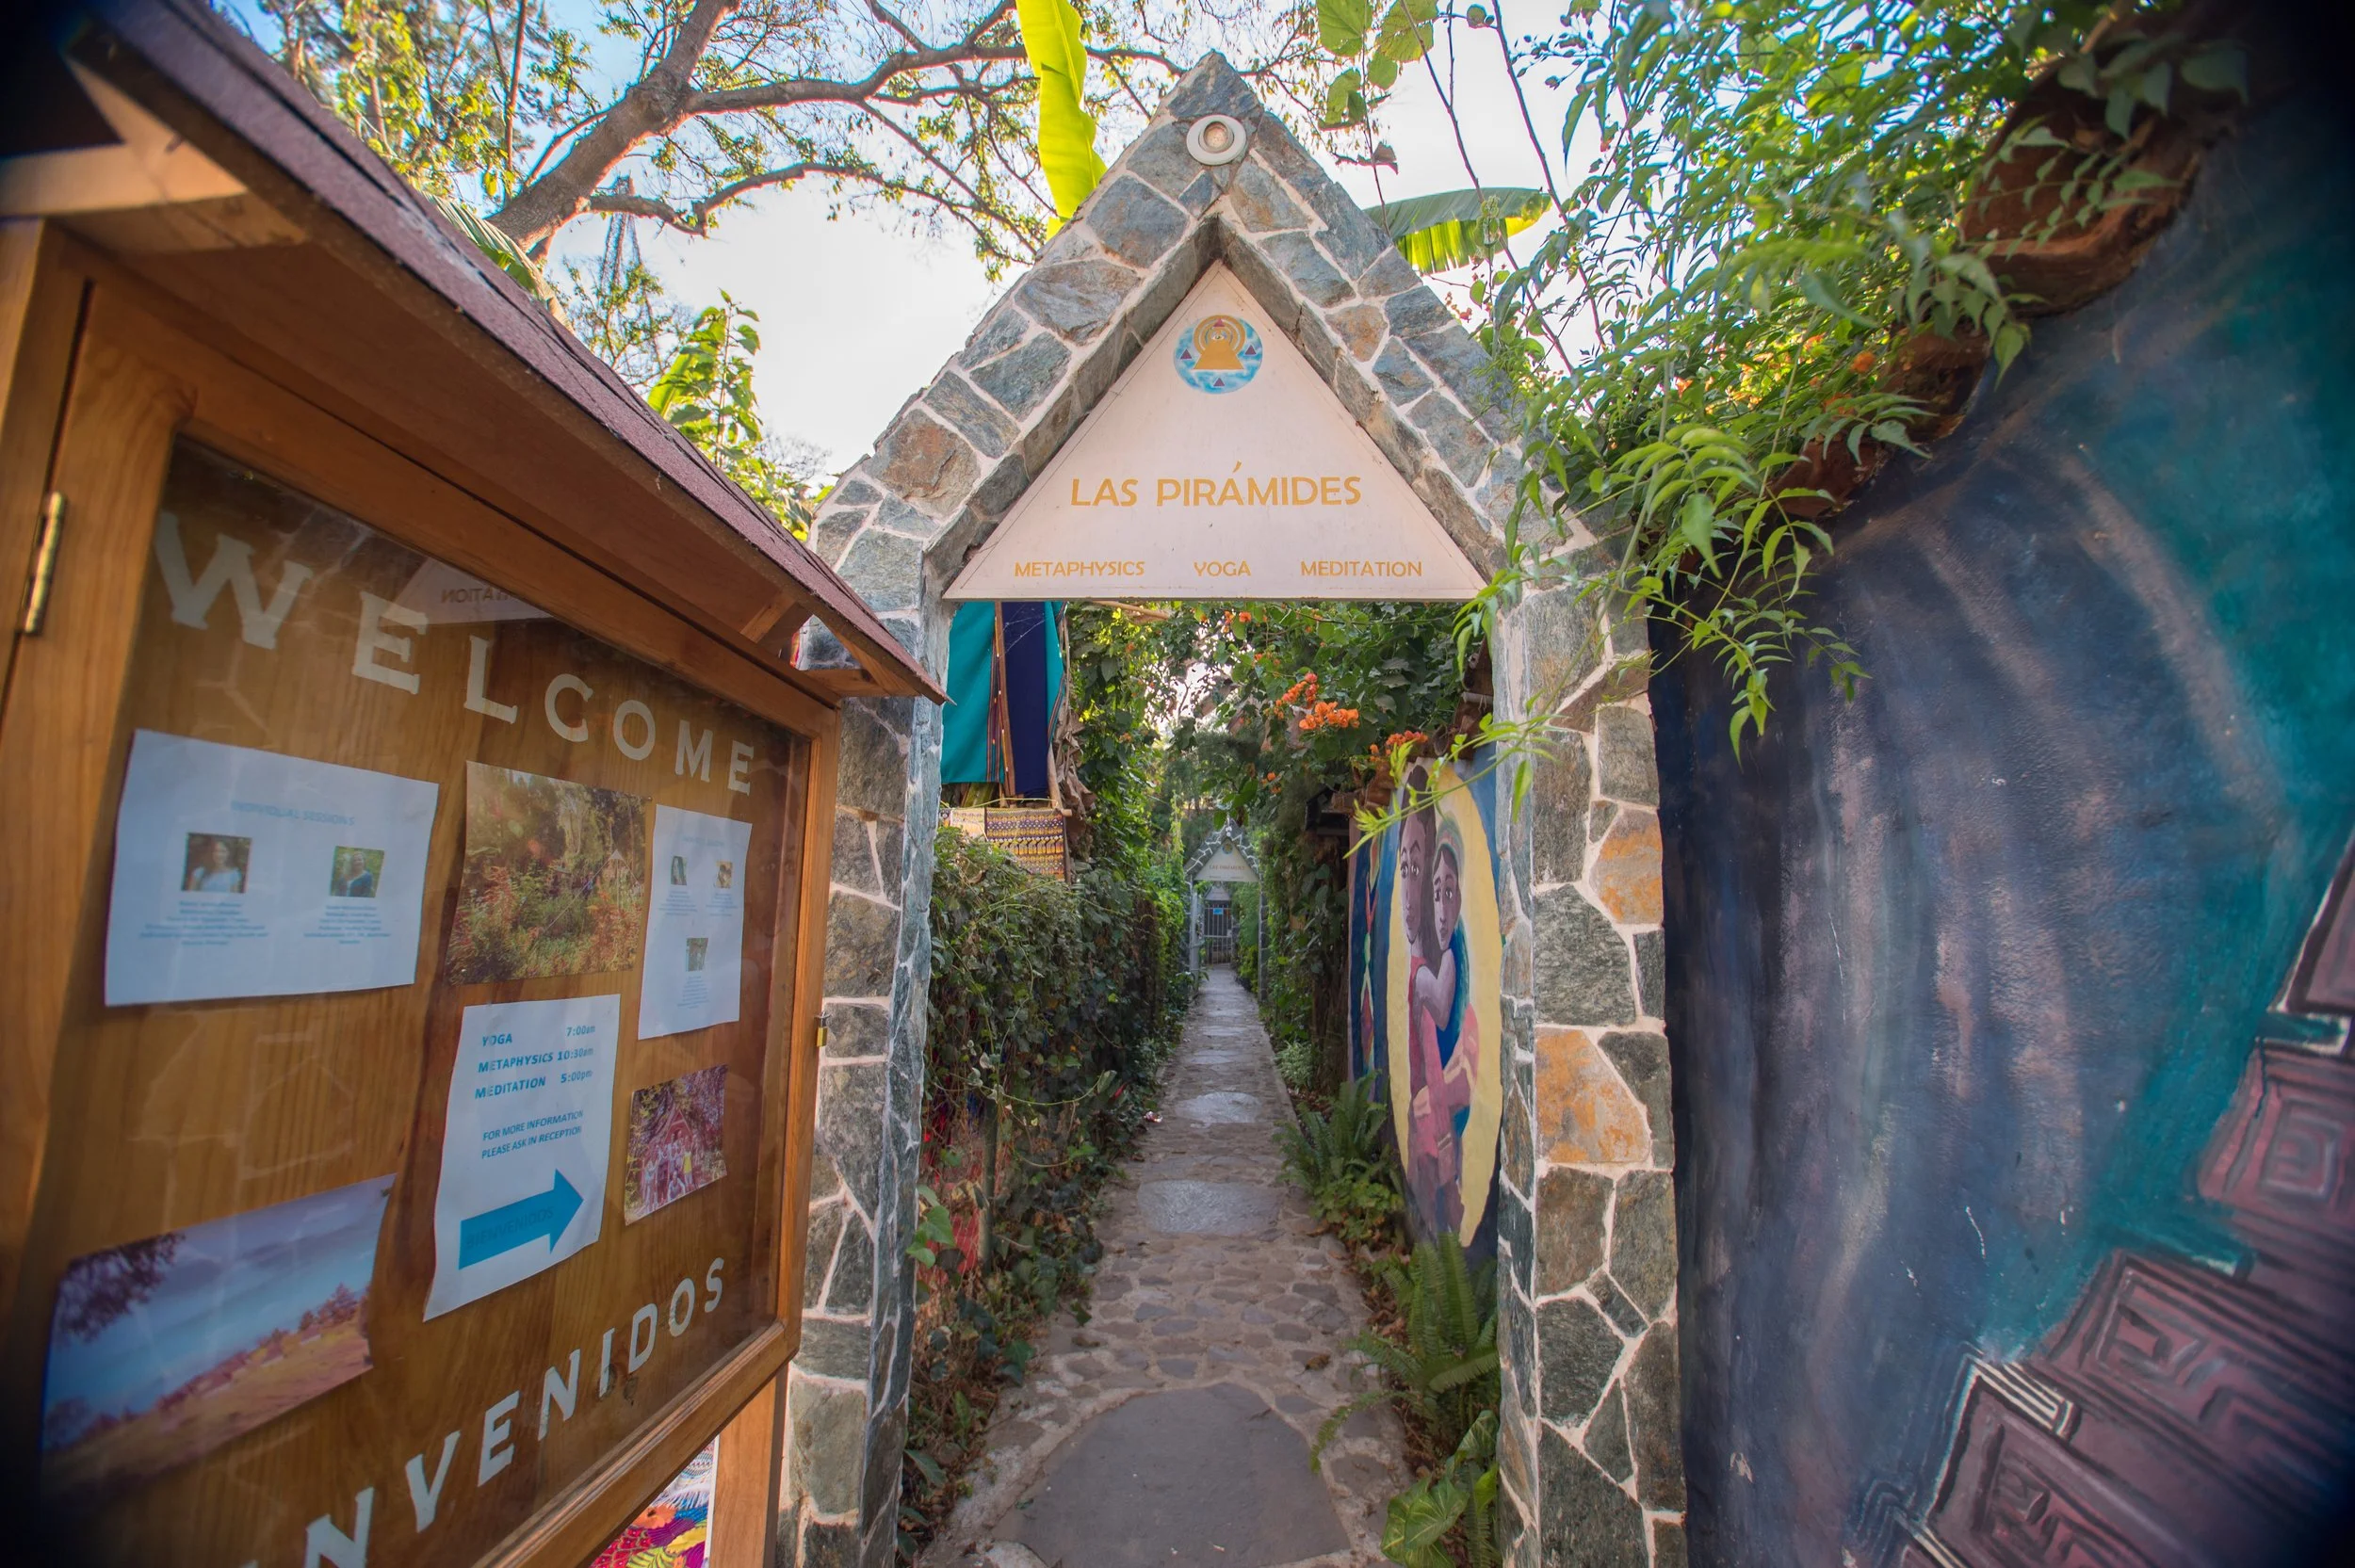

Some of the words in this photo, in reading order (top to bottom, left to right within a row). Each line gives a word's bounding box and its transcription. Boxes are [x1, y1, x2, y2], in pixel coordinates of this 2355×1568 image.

[1071, 477, 1138, 506] LAS
[1157, 461, 1361, 506] PIRÁMIDES
[1015, 560, 1145, 577] METAPHYSICS
[1194, 560, 1251, 576] YOGA
[1300, 560, 1421, 576] MEDITATION
[154, 509, 755, 795] WELCOME
[481, 1033, 512, 1046] YOGA
[566, 1025, 595, 1037] 7:00am
[478, 1052, 554, 1073] METAPHYSICS
[557, 1047, 593, 1061] 10:30am
[475, 1076, 546, 1099] MEDITATION
[560, 1070, 593, 1084] 5:00pm
[482, 1129, 500, 1141] FOR
[502, 1123, 526, 1137] MORE
[527, 1109, 584, 1130] INFORMATION
[481, 1142, 511, 1159] PLEASE
[512, 1139, 528, 1151] ASK
[528, 1136, 538, 1146] IN
[539, 1125, 582, 1143] RECEPTION
